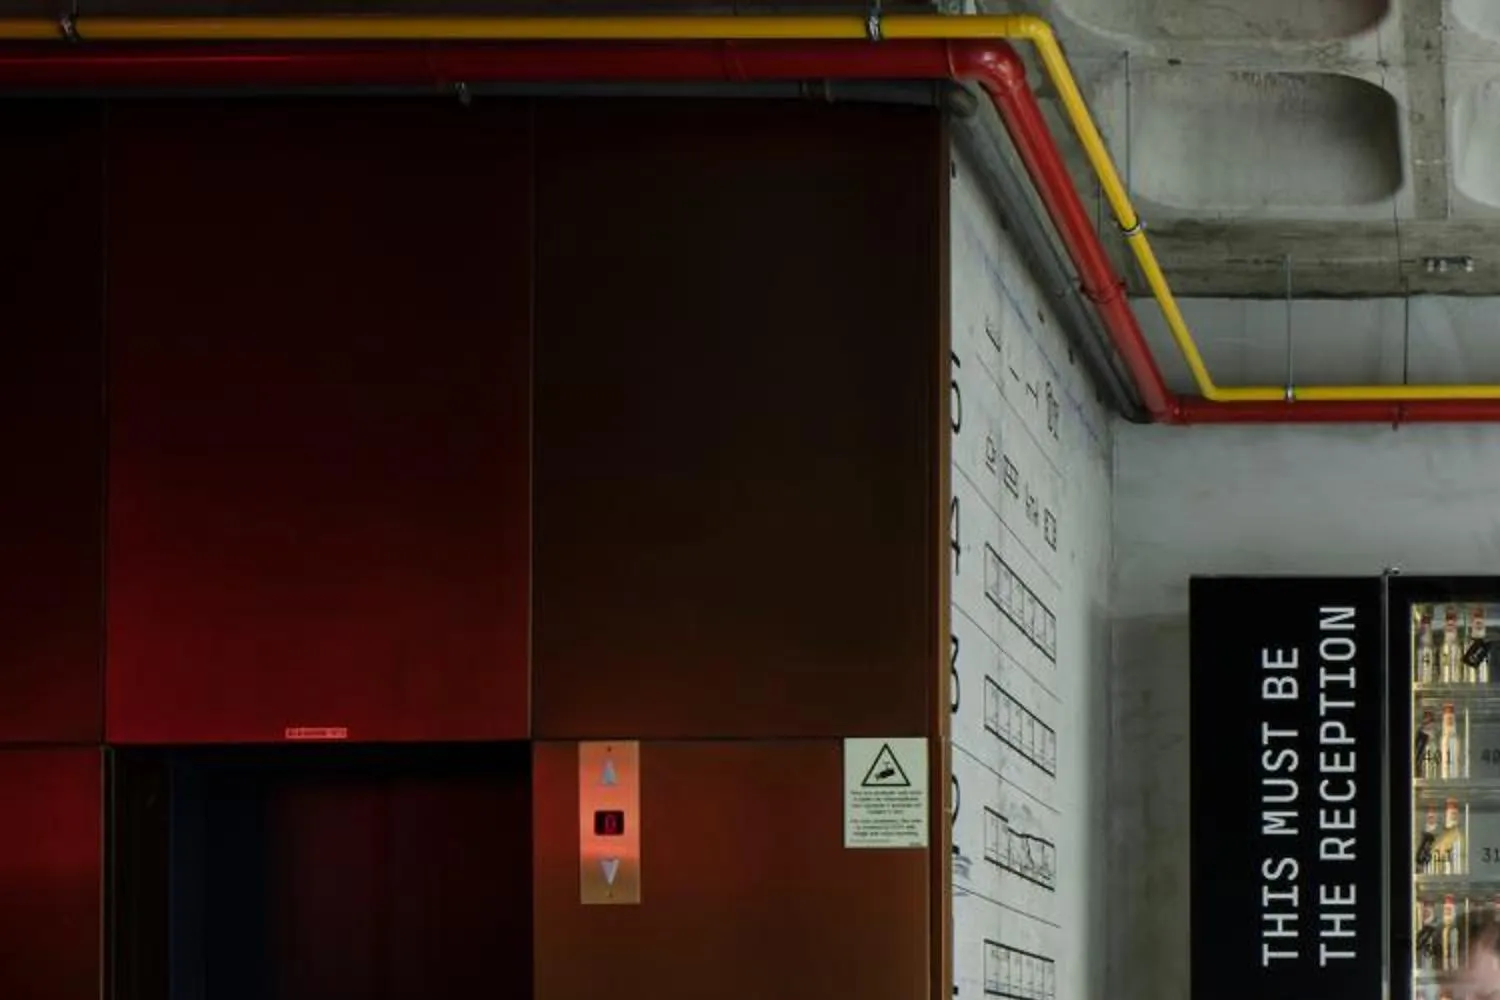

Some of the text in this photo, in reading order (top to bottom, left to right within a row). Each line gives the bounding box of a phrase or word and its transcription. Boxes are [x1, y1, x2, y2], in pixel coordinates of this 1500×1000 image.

[1262, 646, 1299, 967] THIS MUST BE
[1319, 606, 1357, 967] THE RECEPTION
